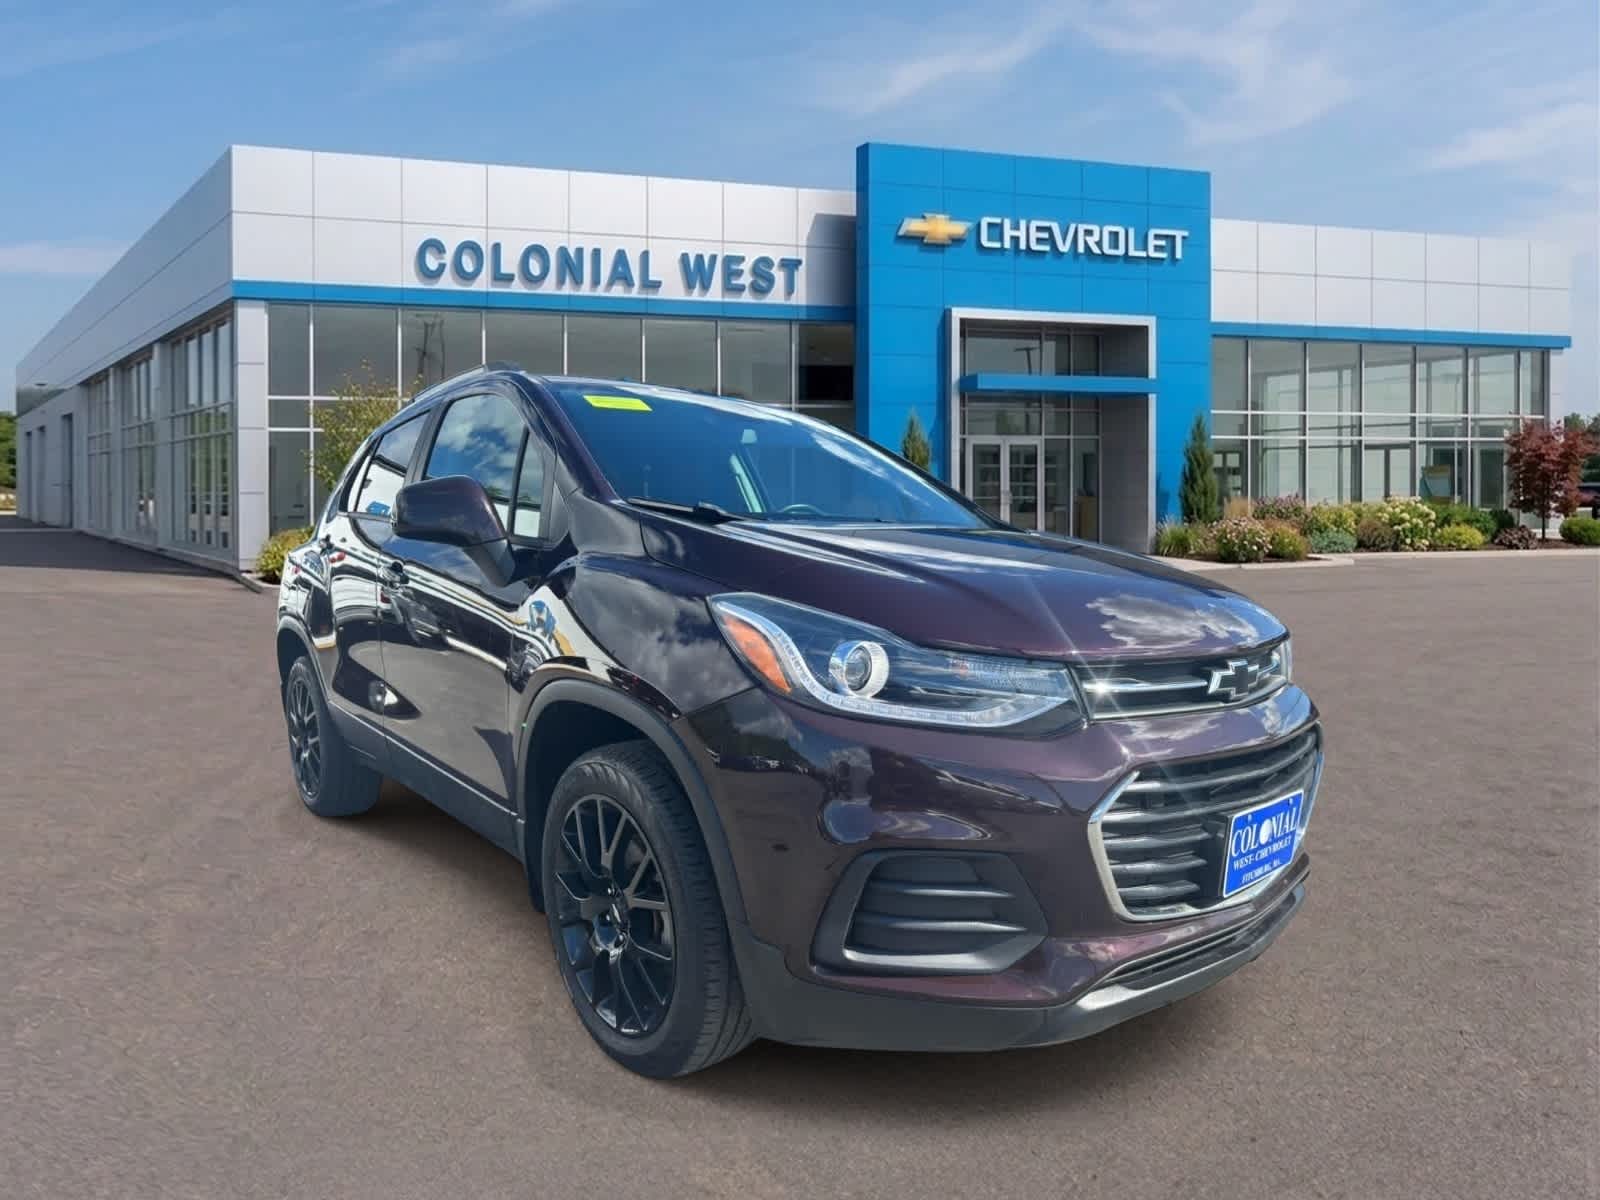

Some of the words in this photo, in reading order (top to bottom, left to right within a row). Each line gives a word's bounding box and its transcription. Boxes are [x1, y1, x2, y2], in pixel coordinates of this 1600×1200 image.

[979, 216, 1189, 261] CHEVROLET
[415, 237, 662, 291] COLONIAL
[679, 251, 803, 296] WEST
